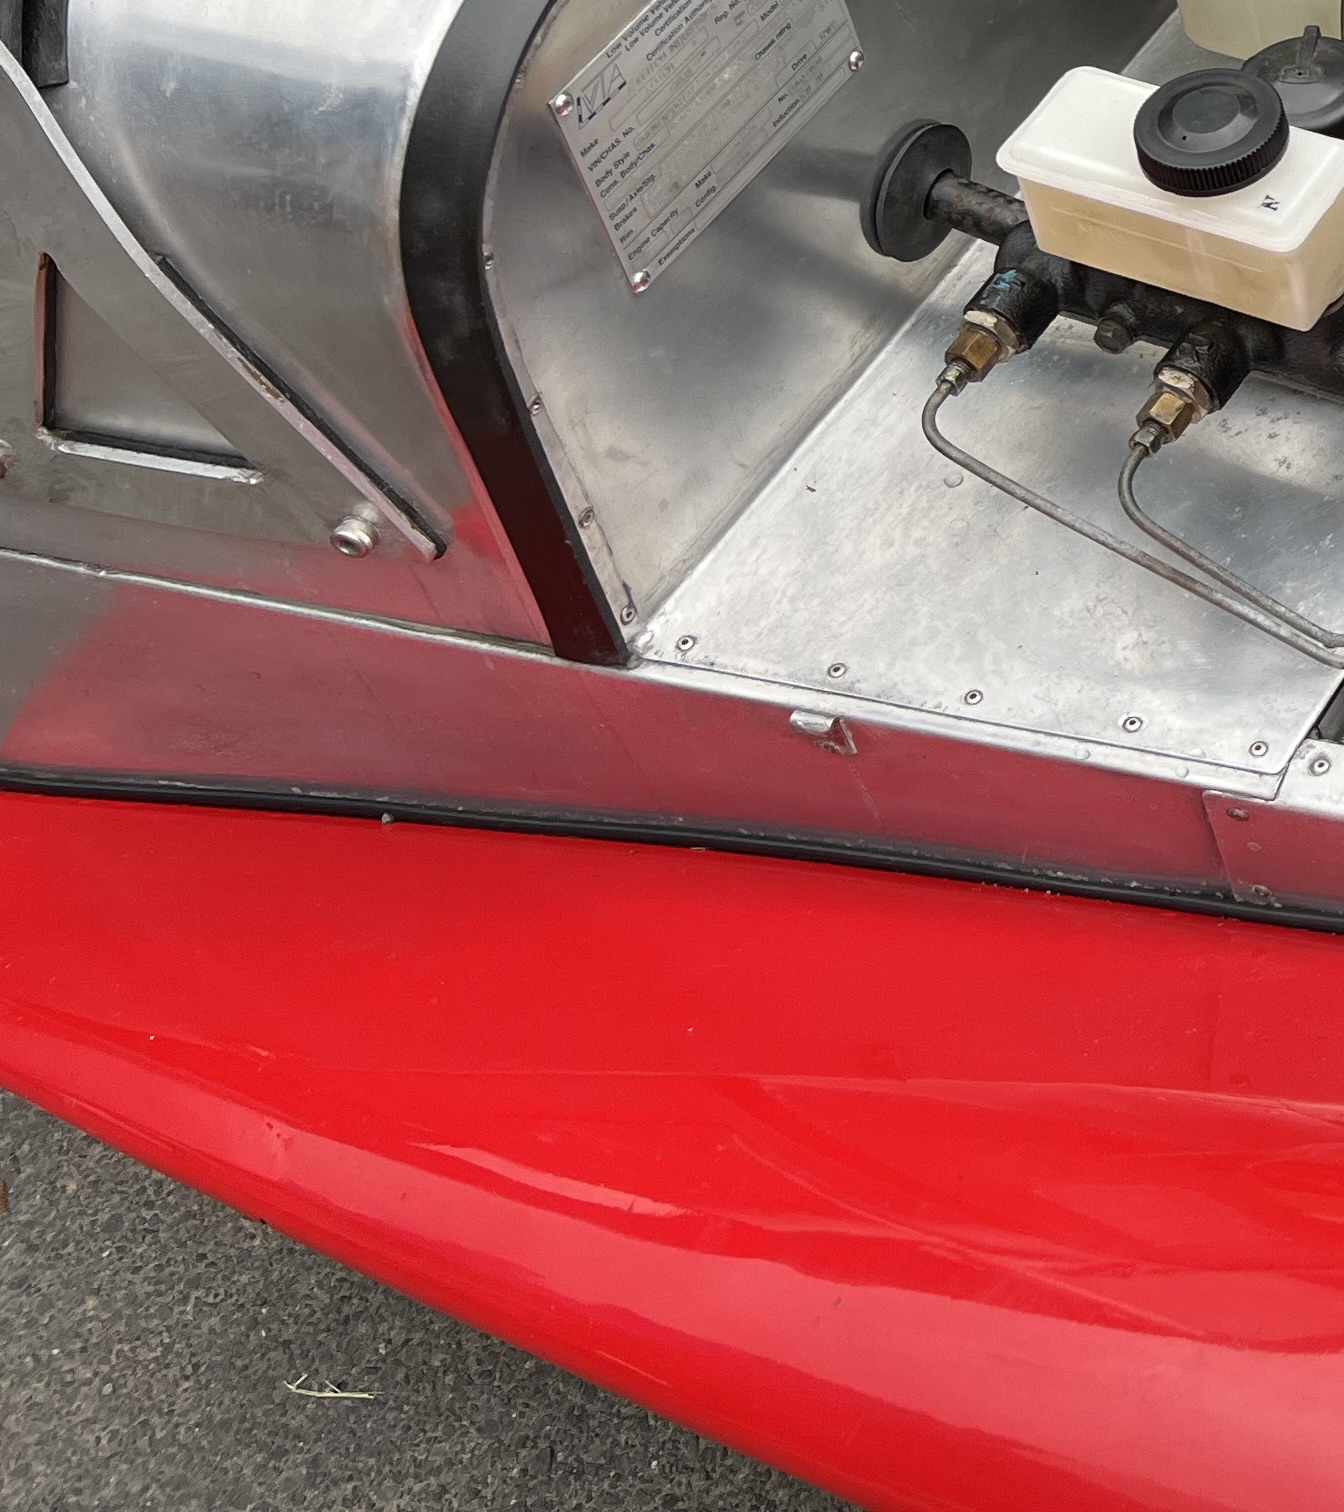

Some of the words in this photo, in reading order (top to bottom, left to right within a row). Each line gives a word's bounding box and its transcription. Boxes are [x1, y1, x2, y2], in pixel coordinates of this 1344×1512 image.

[623, 14, 649, 42] Volume
[640, 11, 663, 36] Volume
[646, 22, 683, 61] Certification
[772, 97, 800, 128] Induction
[614, 205, 637, 231] Brakes
[627, 235, 650, 261] Engine
[650, 207, 678, 238] Capacity
